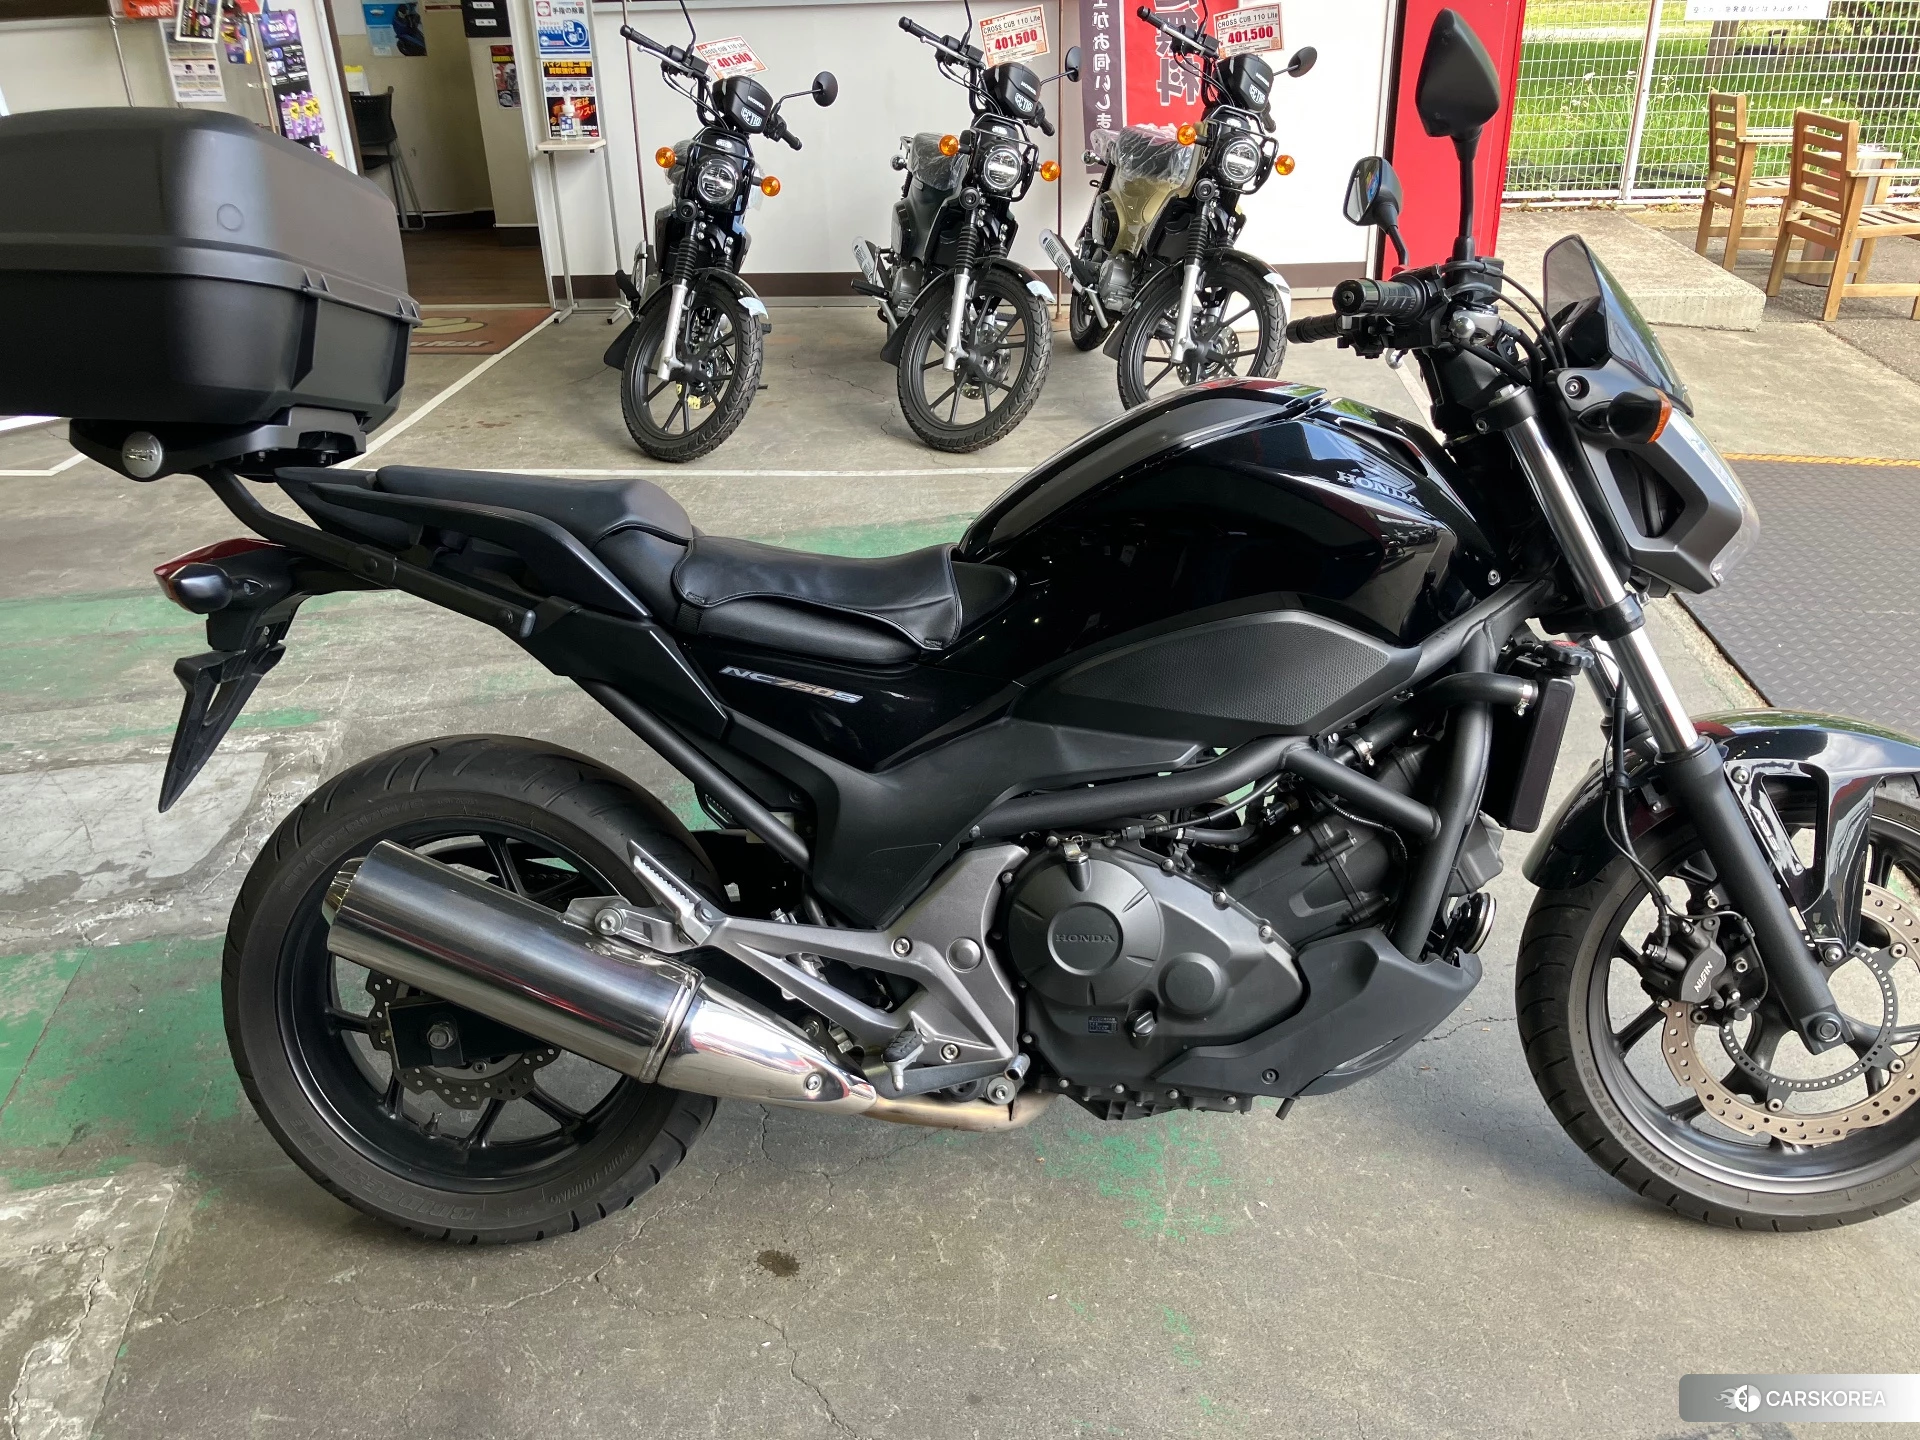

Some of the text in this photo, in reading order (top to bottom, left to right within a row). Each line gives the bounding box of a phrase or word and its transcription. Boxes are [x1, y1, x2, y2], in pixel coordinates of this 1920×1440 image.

[983, 22, 1002, 35] CROSS
[1003, 20, 1016, 29] CUB
[1017, 18, 1029, 27] 110
[1217, 18, 1238, 29] CROSS
[1238, 16, 1252, 25] CUB
[1253, 13, 1267, 22] 110
[994, 29, 1038, 51] 401,500
[1227, 25, 1274, 45] 401,500
[717, 52, 753, 68] 401,500
[747, 95, 766, 111] HONDA
[1336, 470, 1425, 508] HONDA
[718, 665, 864, 704] NC750S
[1055, 933, 1116, 943] HONDA
